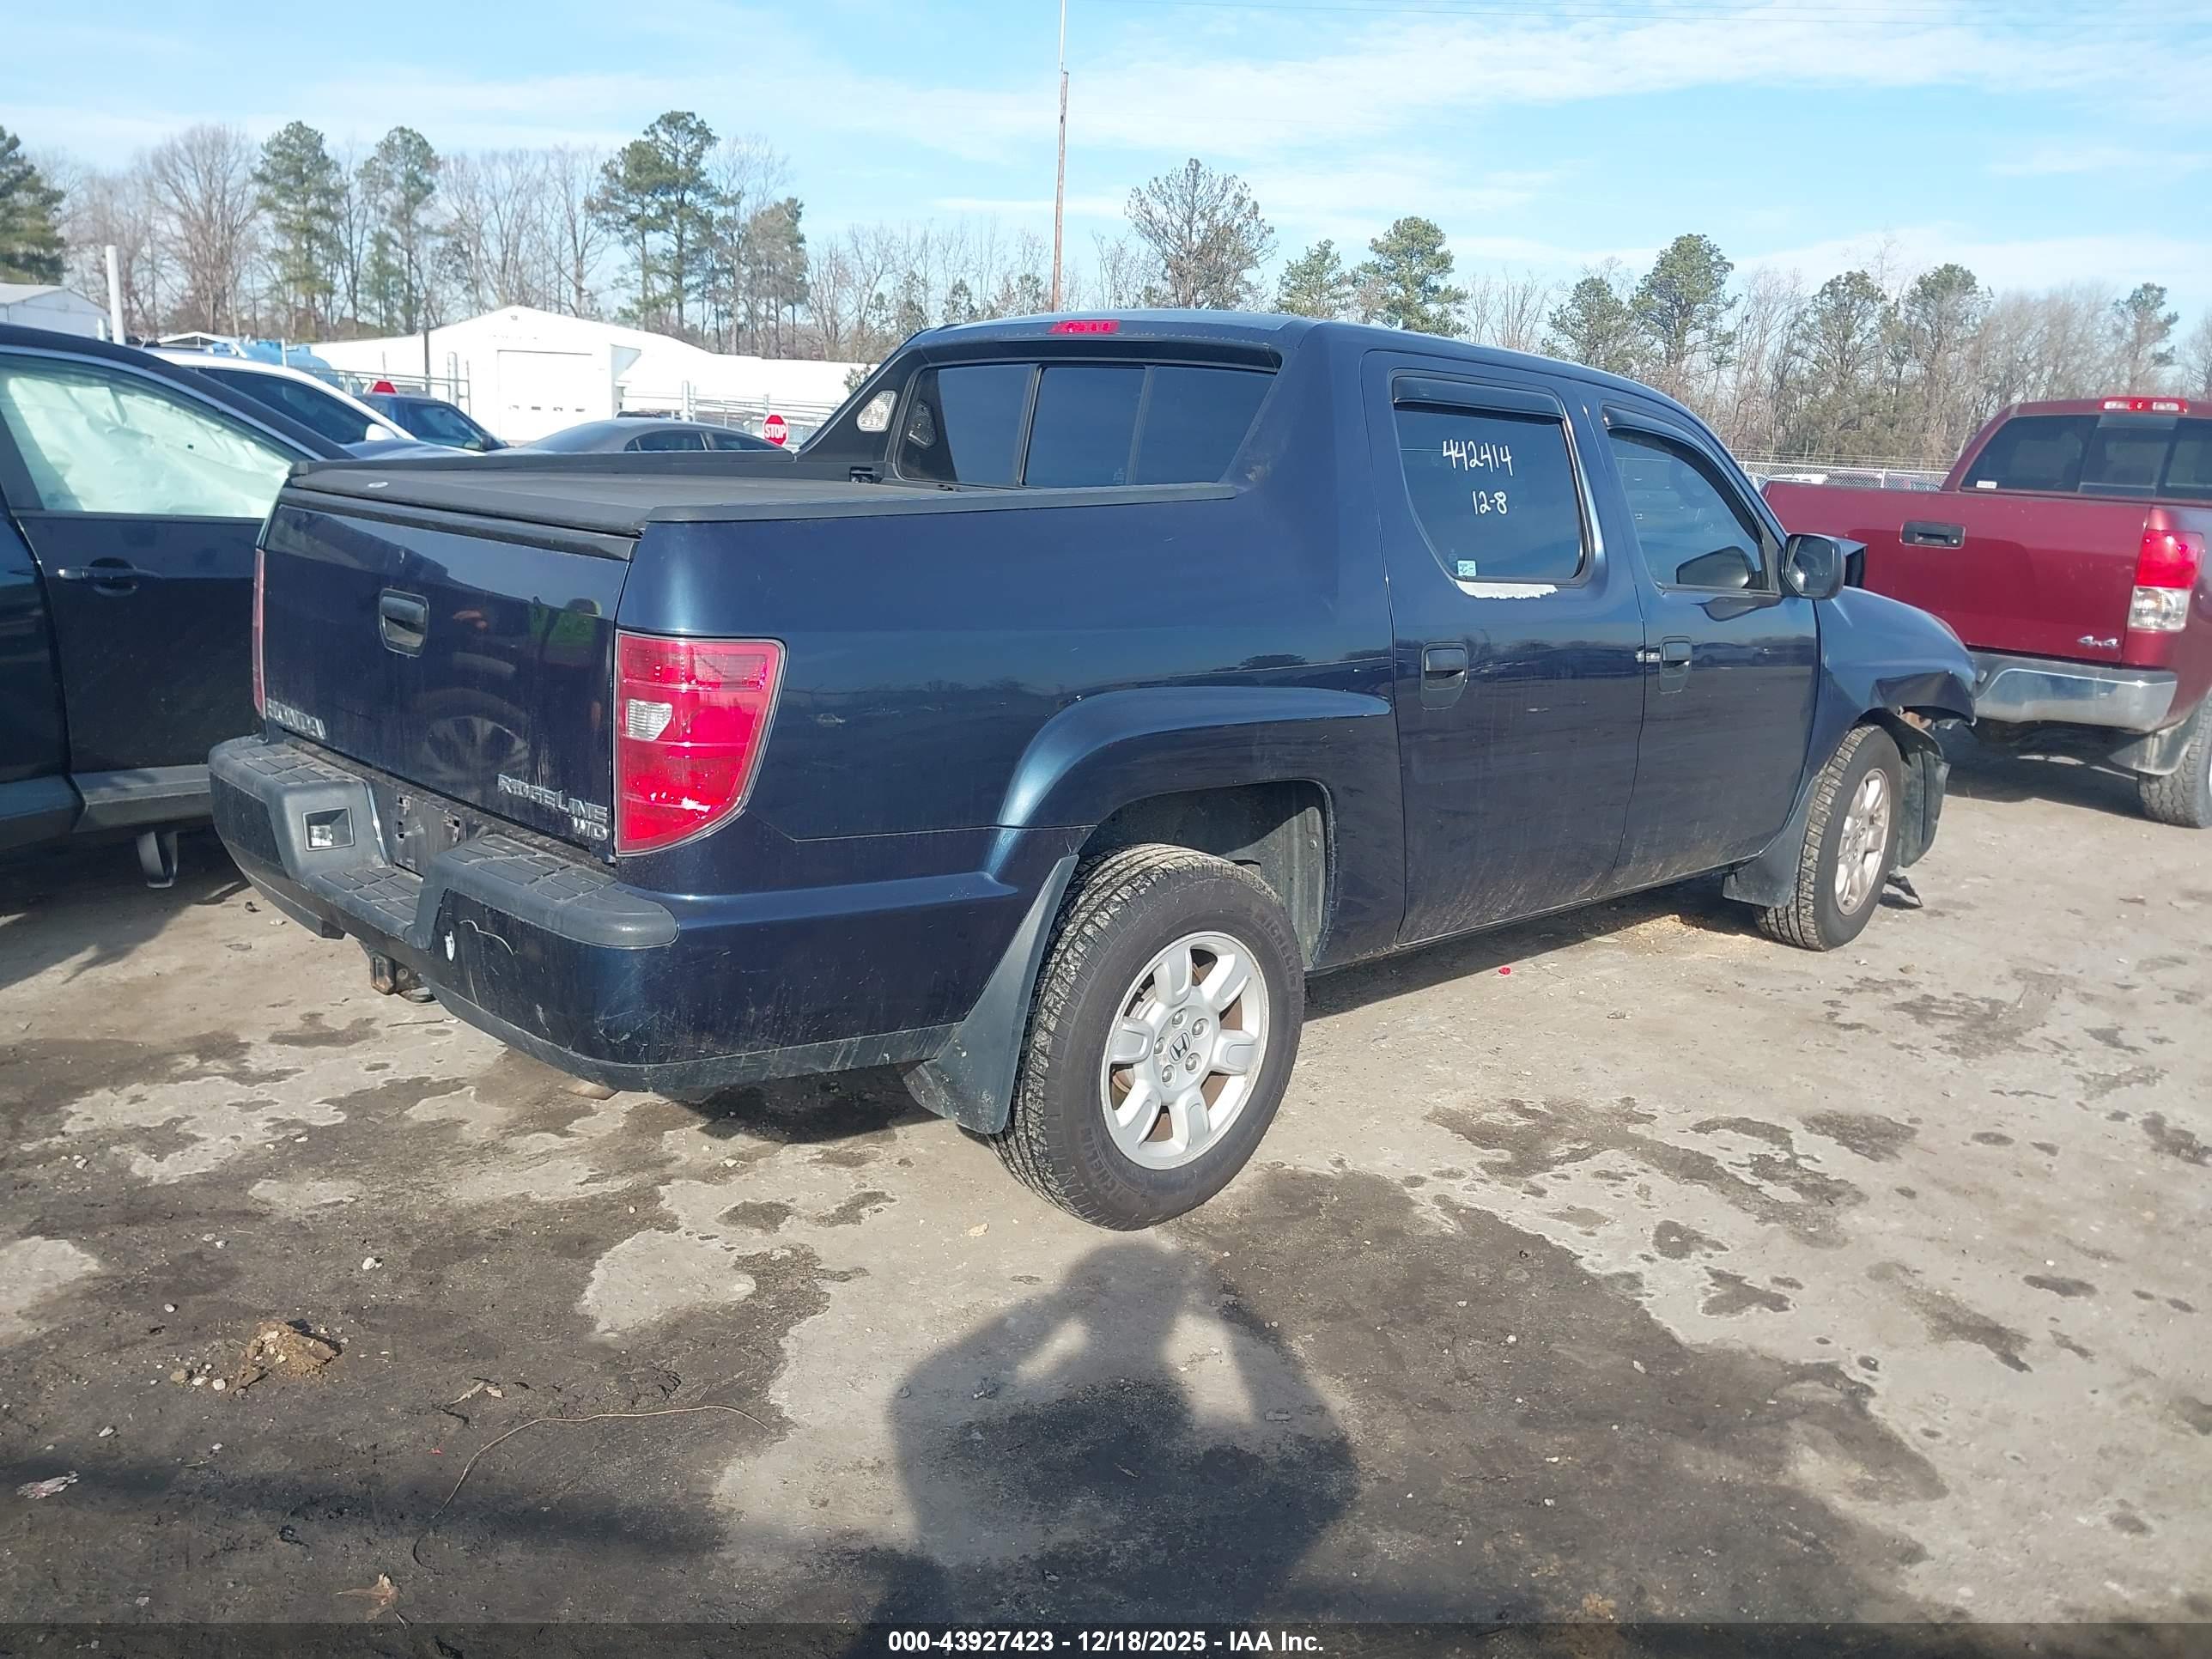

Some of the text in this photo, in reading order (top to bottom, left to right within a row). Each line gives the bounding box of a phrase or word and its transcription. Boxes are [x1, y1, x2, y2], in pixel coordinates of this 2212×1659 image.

[764, 424, 787, 439] STOP
[1443, 439, 1514, 477] 442414
[1472, 490, 1508, 515] 12-8
[497, 773, 608, 823] RIDGELINE
